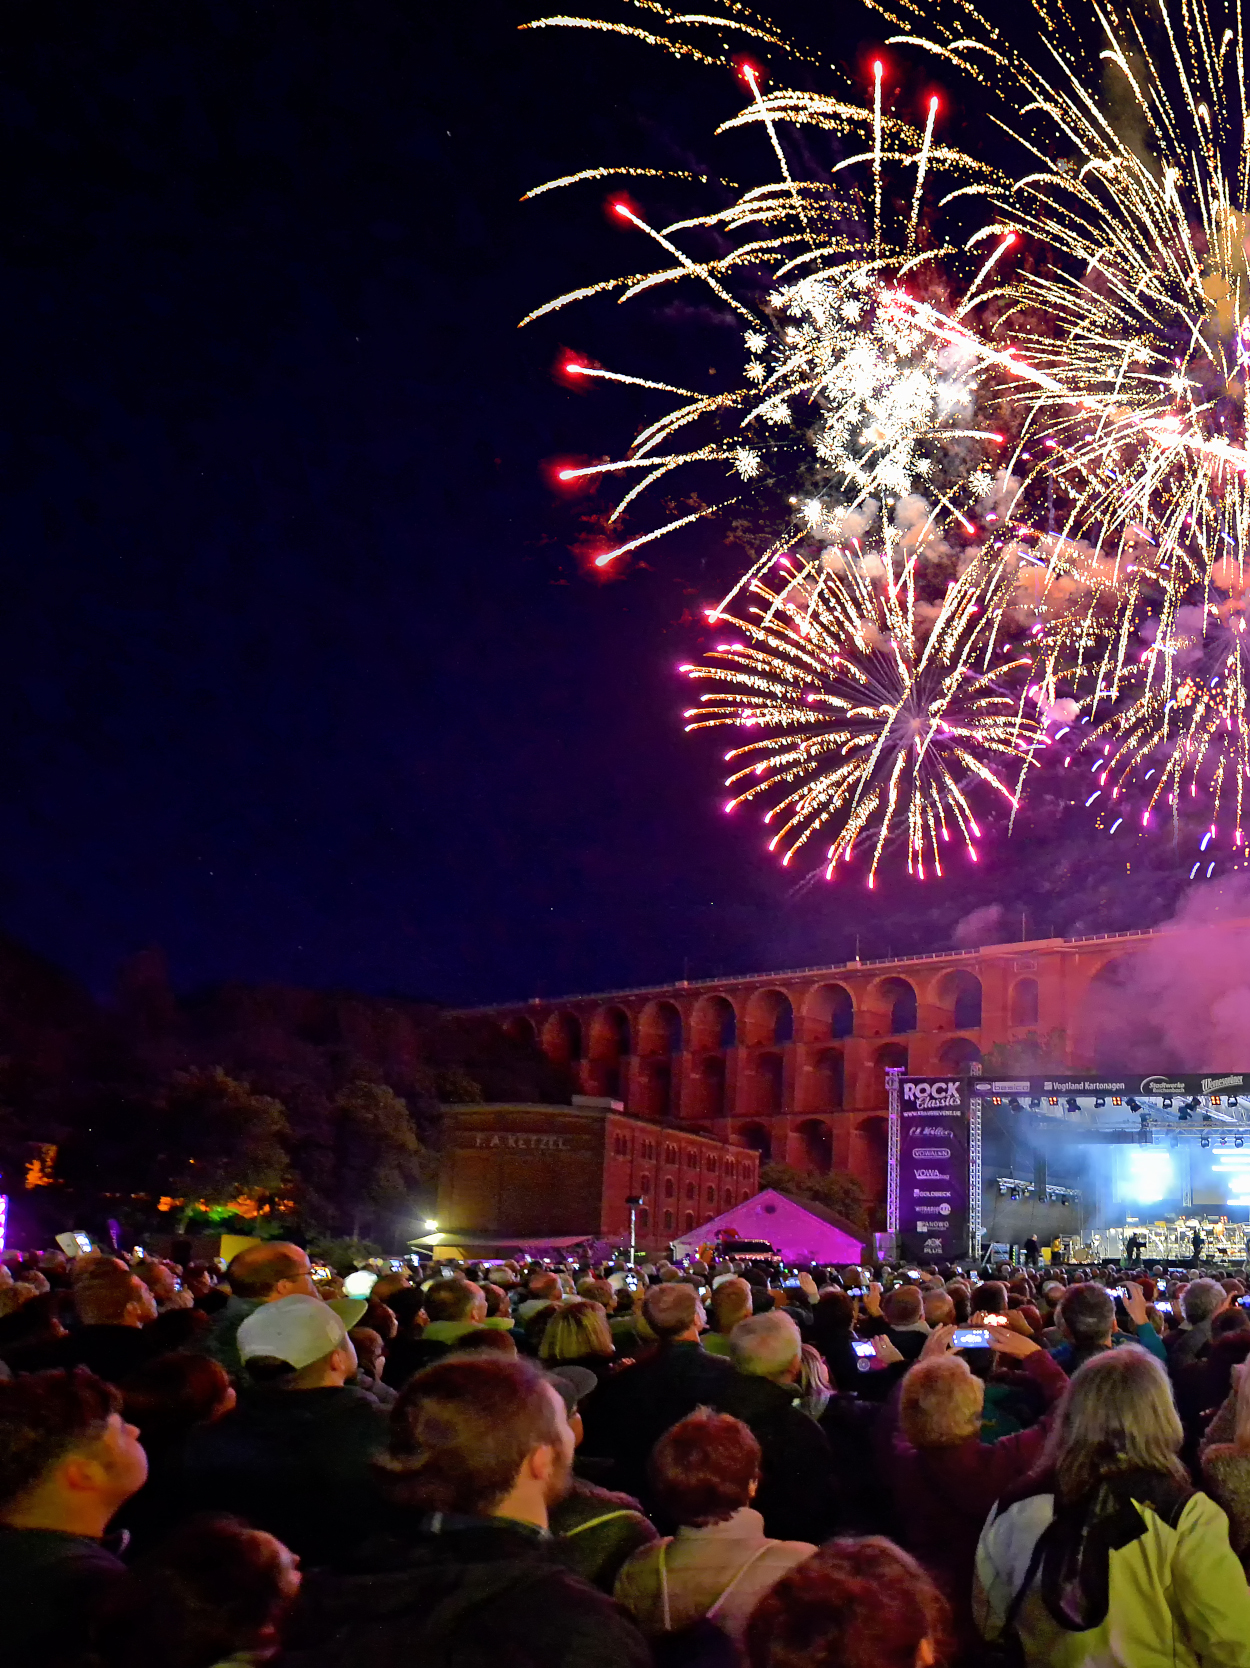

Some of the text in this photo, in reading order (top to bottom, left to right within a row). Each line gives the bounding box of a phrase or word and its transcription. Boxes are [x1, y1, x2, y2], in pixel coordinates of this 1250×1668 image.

[903, 1081, 960, 1101] ROCK
[1053, 1081, 1125, 1092] Vogtland Kartonagen
[1148, 1081, 1185, 1089] Stadtwerke
[916, 1095, 961, 1109] Classics
